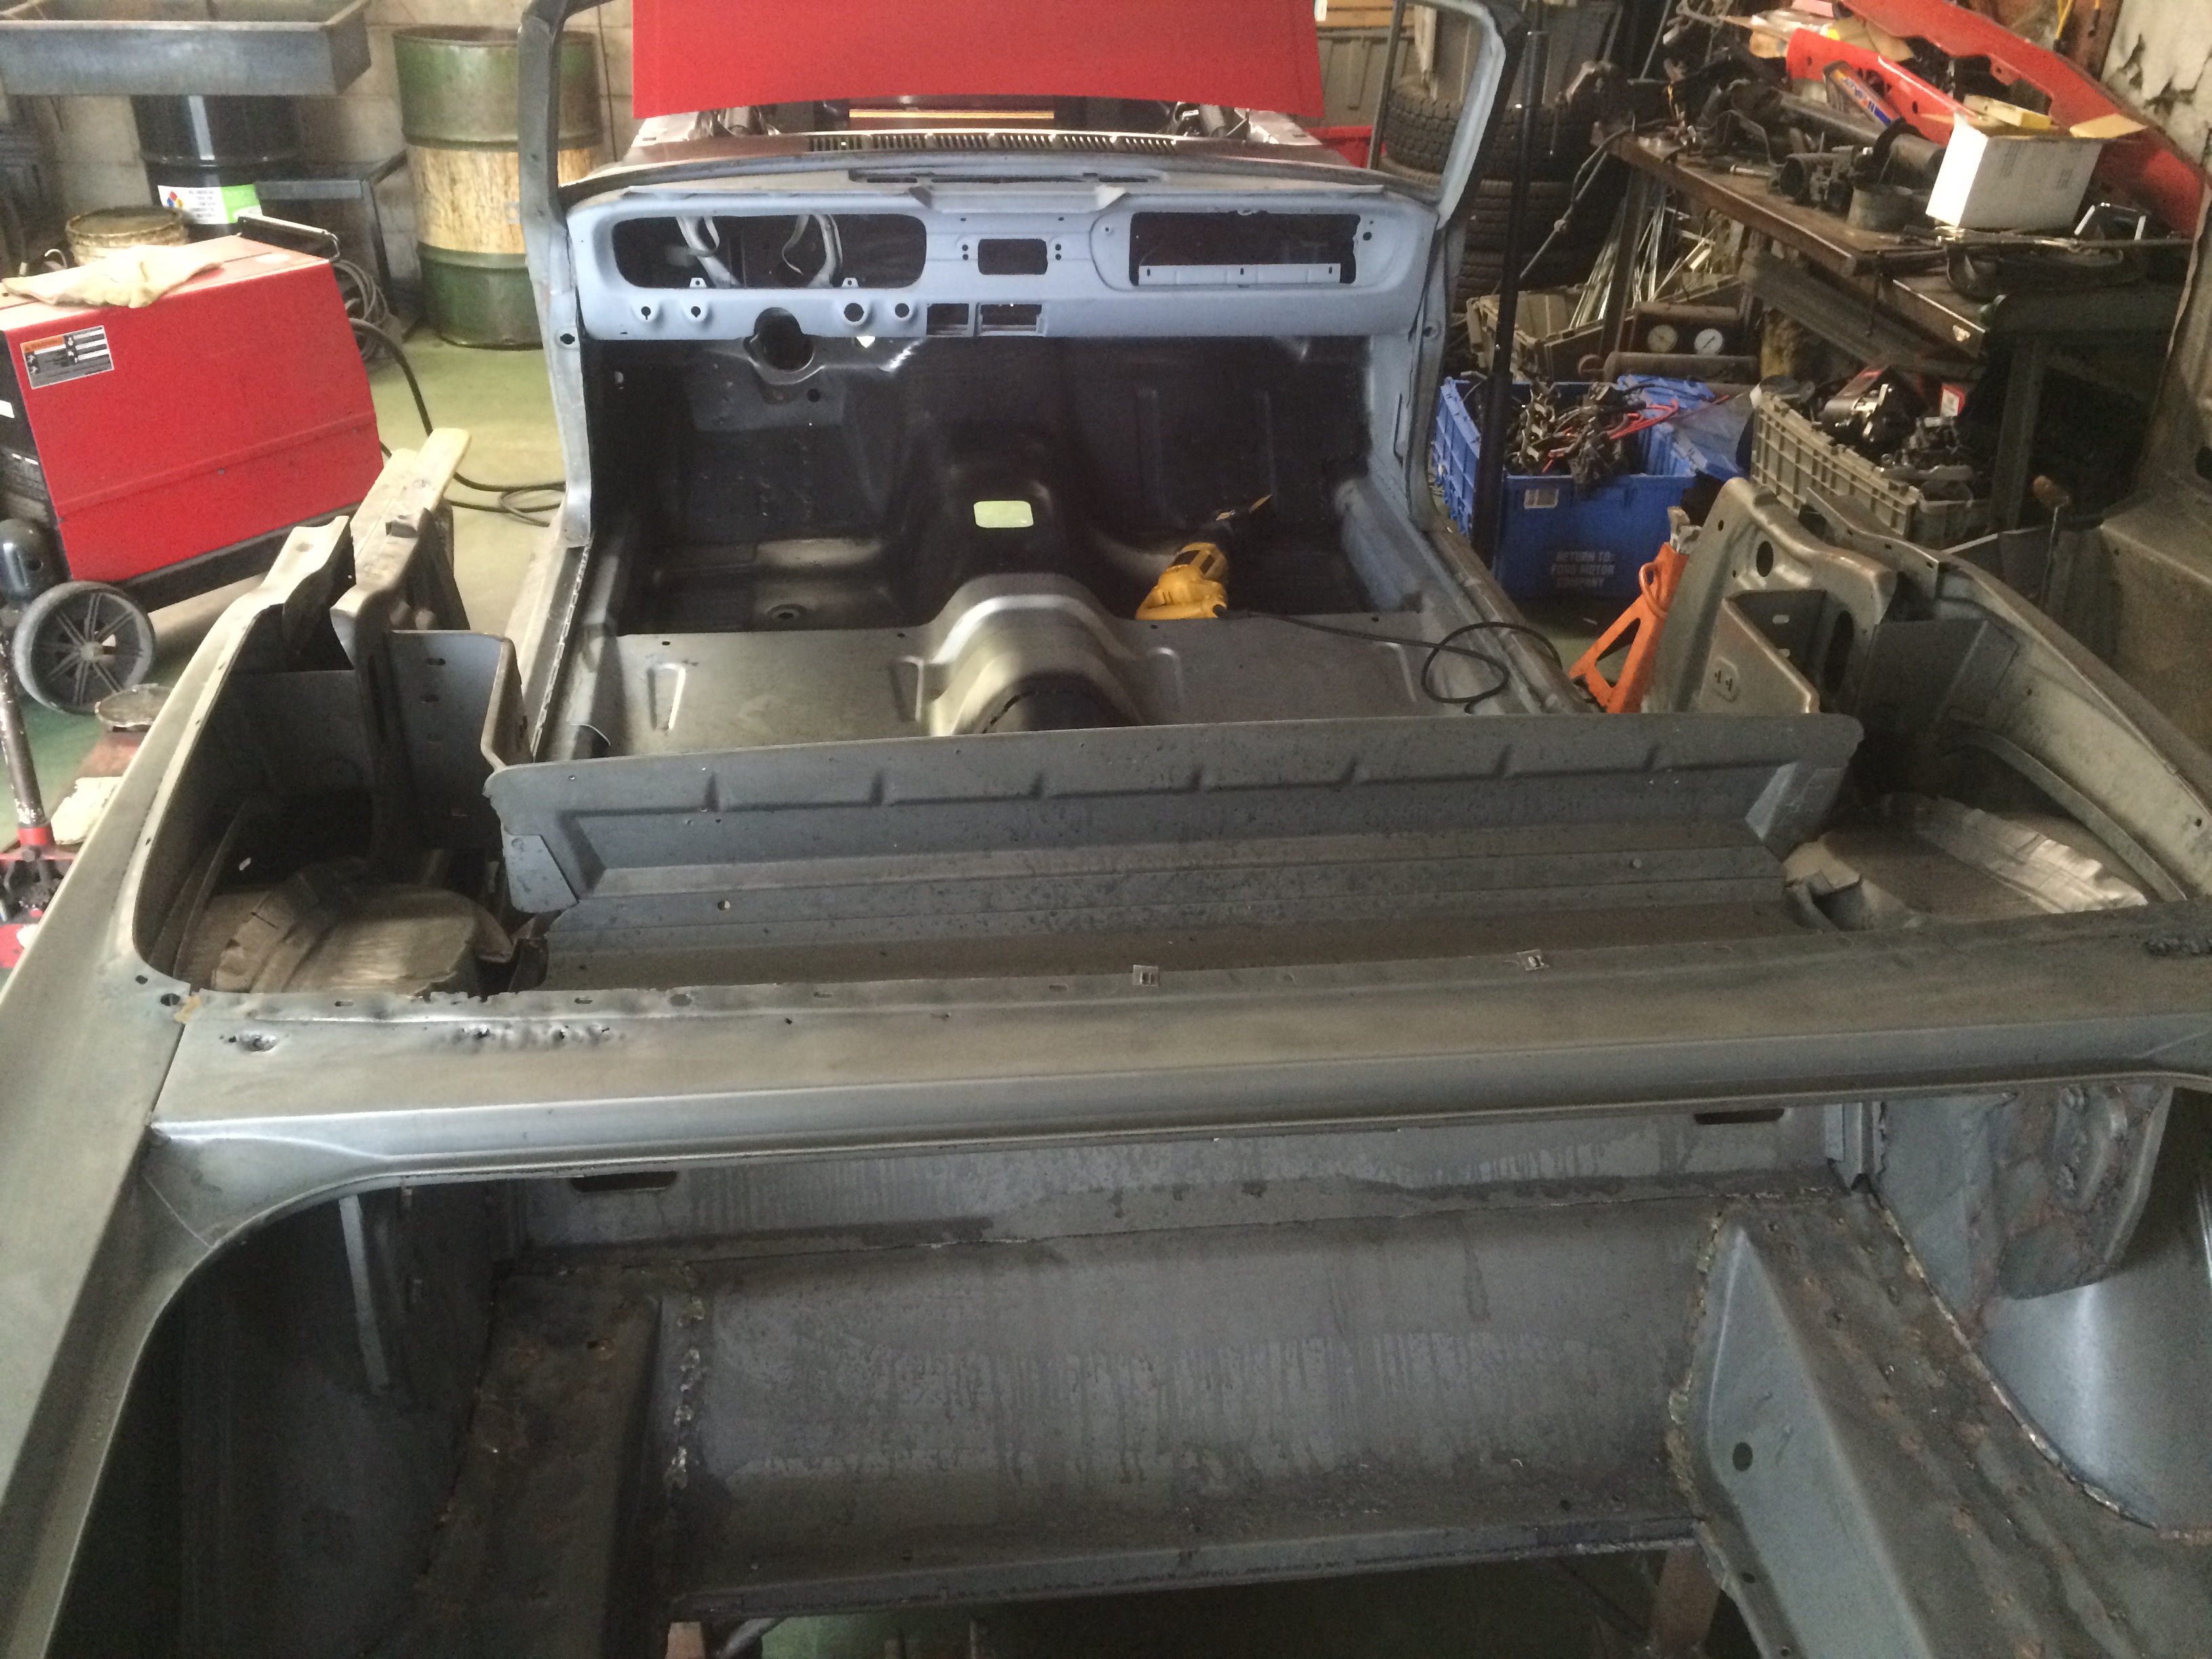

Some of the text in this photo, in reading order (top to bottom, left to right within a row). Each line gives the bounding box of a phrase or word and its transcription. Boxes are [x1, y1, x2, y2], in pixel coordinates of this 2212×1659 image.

[1556, 551, 1595, 562] RETURN
[1551, 564, 1615, 575] FORD MOTOR
[1556, 577, 1605, 588] COMPANY
